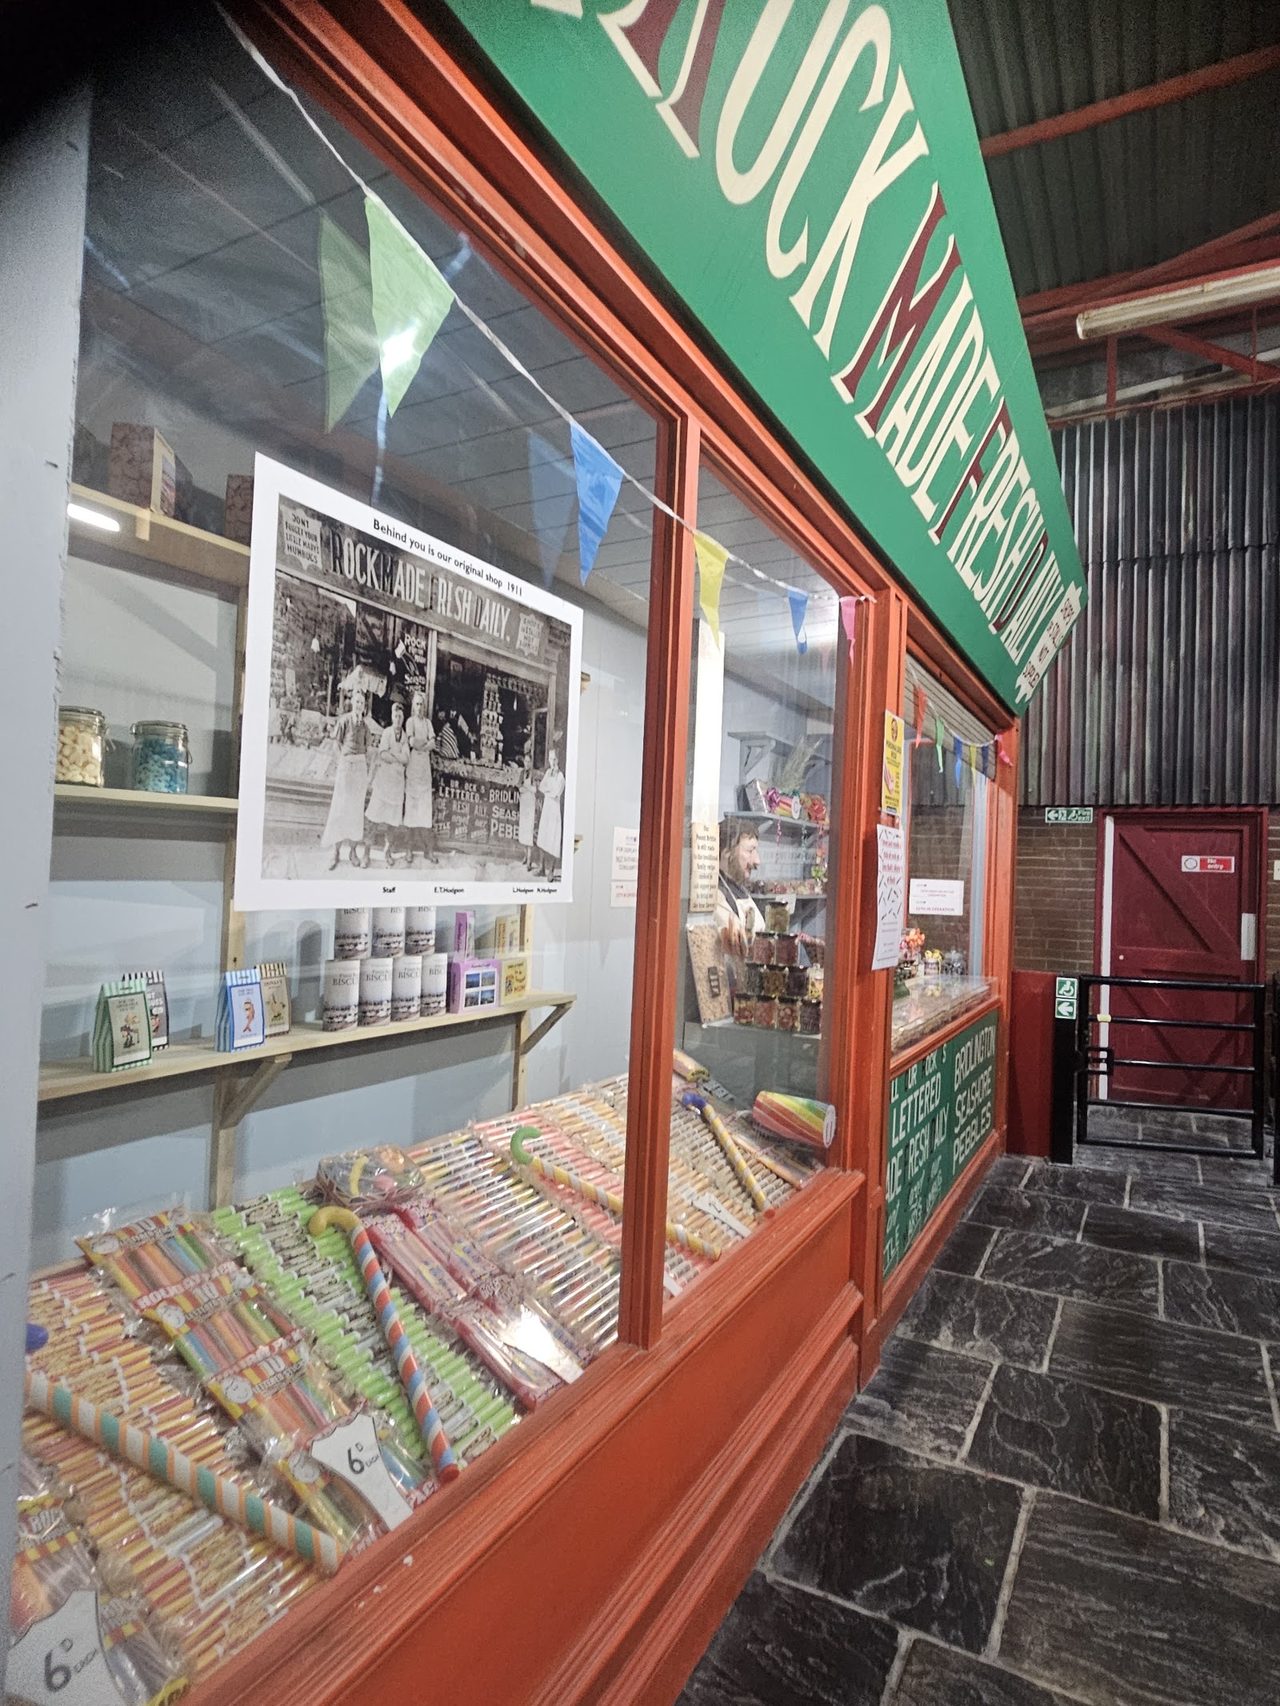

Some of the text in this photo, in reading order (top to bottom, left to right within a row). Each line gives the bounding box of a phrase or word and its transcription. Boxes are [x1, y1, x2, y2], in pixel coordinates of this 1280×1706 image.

[831, 181, 1000, 523] MADE
[928, 396, 1044, 621] FRESH
[988, 528, 1065, 666] DAILY
[330, 528, 381, 591] ROCK
[380, 552, 426, 609] MADE
[373, 518, 523, 596] Behind you is our original shop 1911
[489, 788, 520, 804] BRIDLIN
[492, 805, 520, 821] SEAS
[954, 1025, 996, 1092] BRIDLINGTON
[892, 1072, 941, 1149] LETTERED
[954, 1065, 992, 1133] SEASHORE
[953, 1101, 992, 1175] PEBBLES
